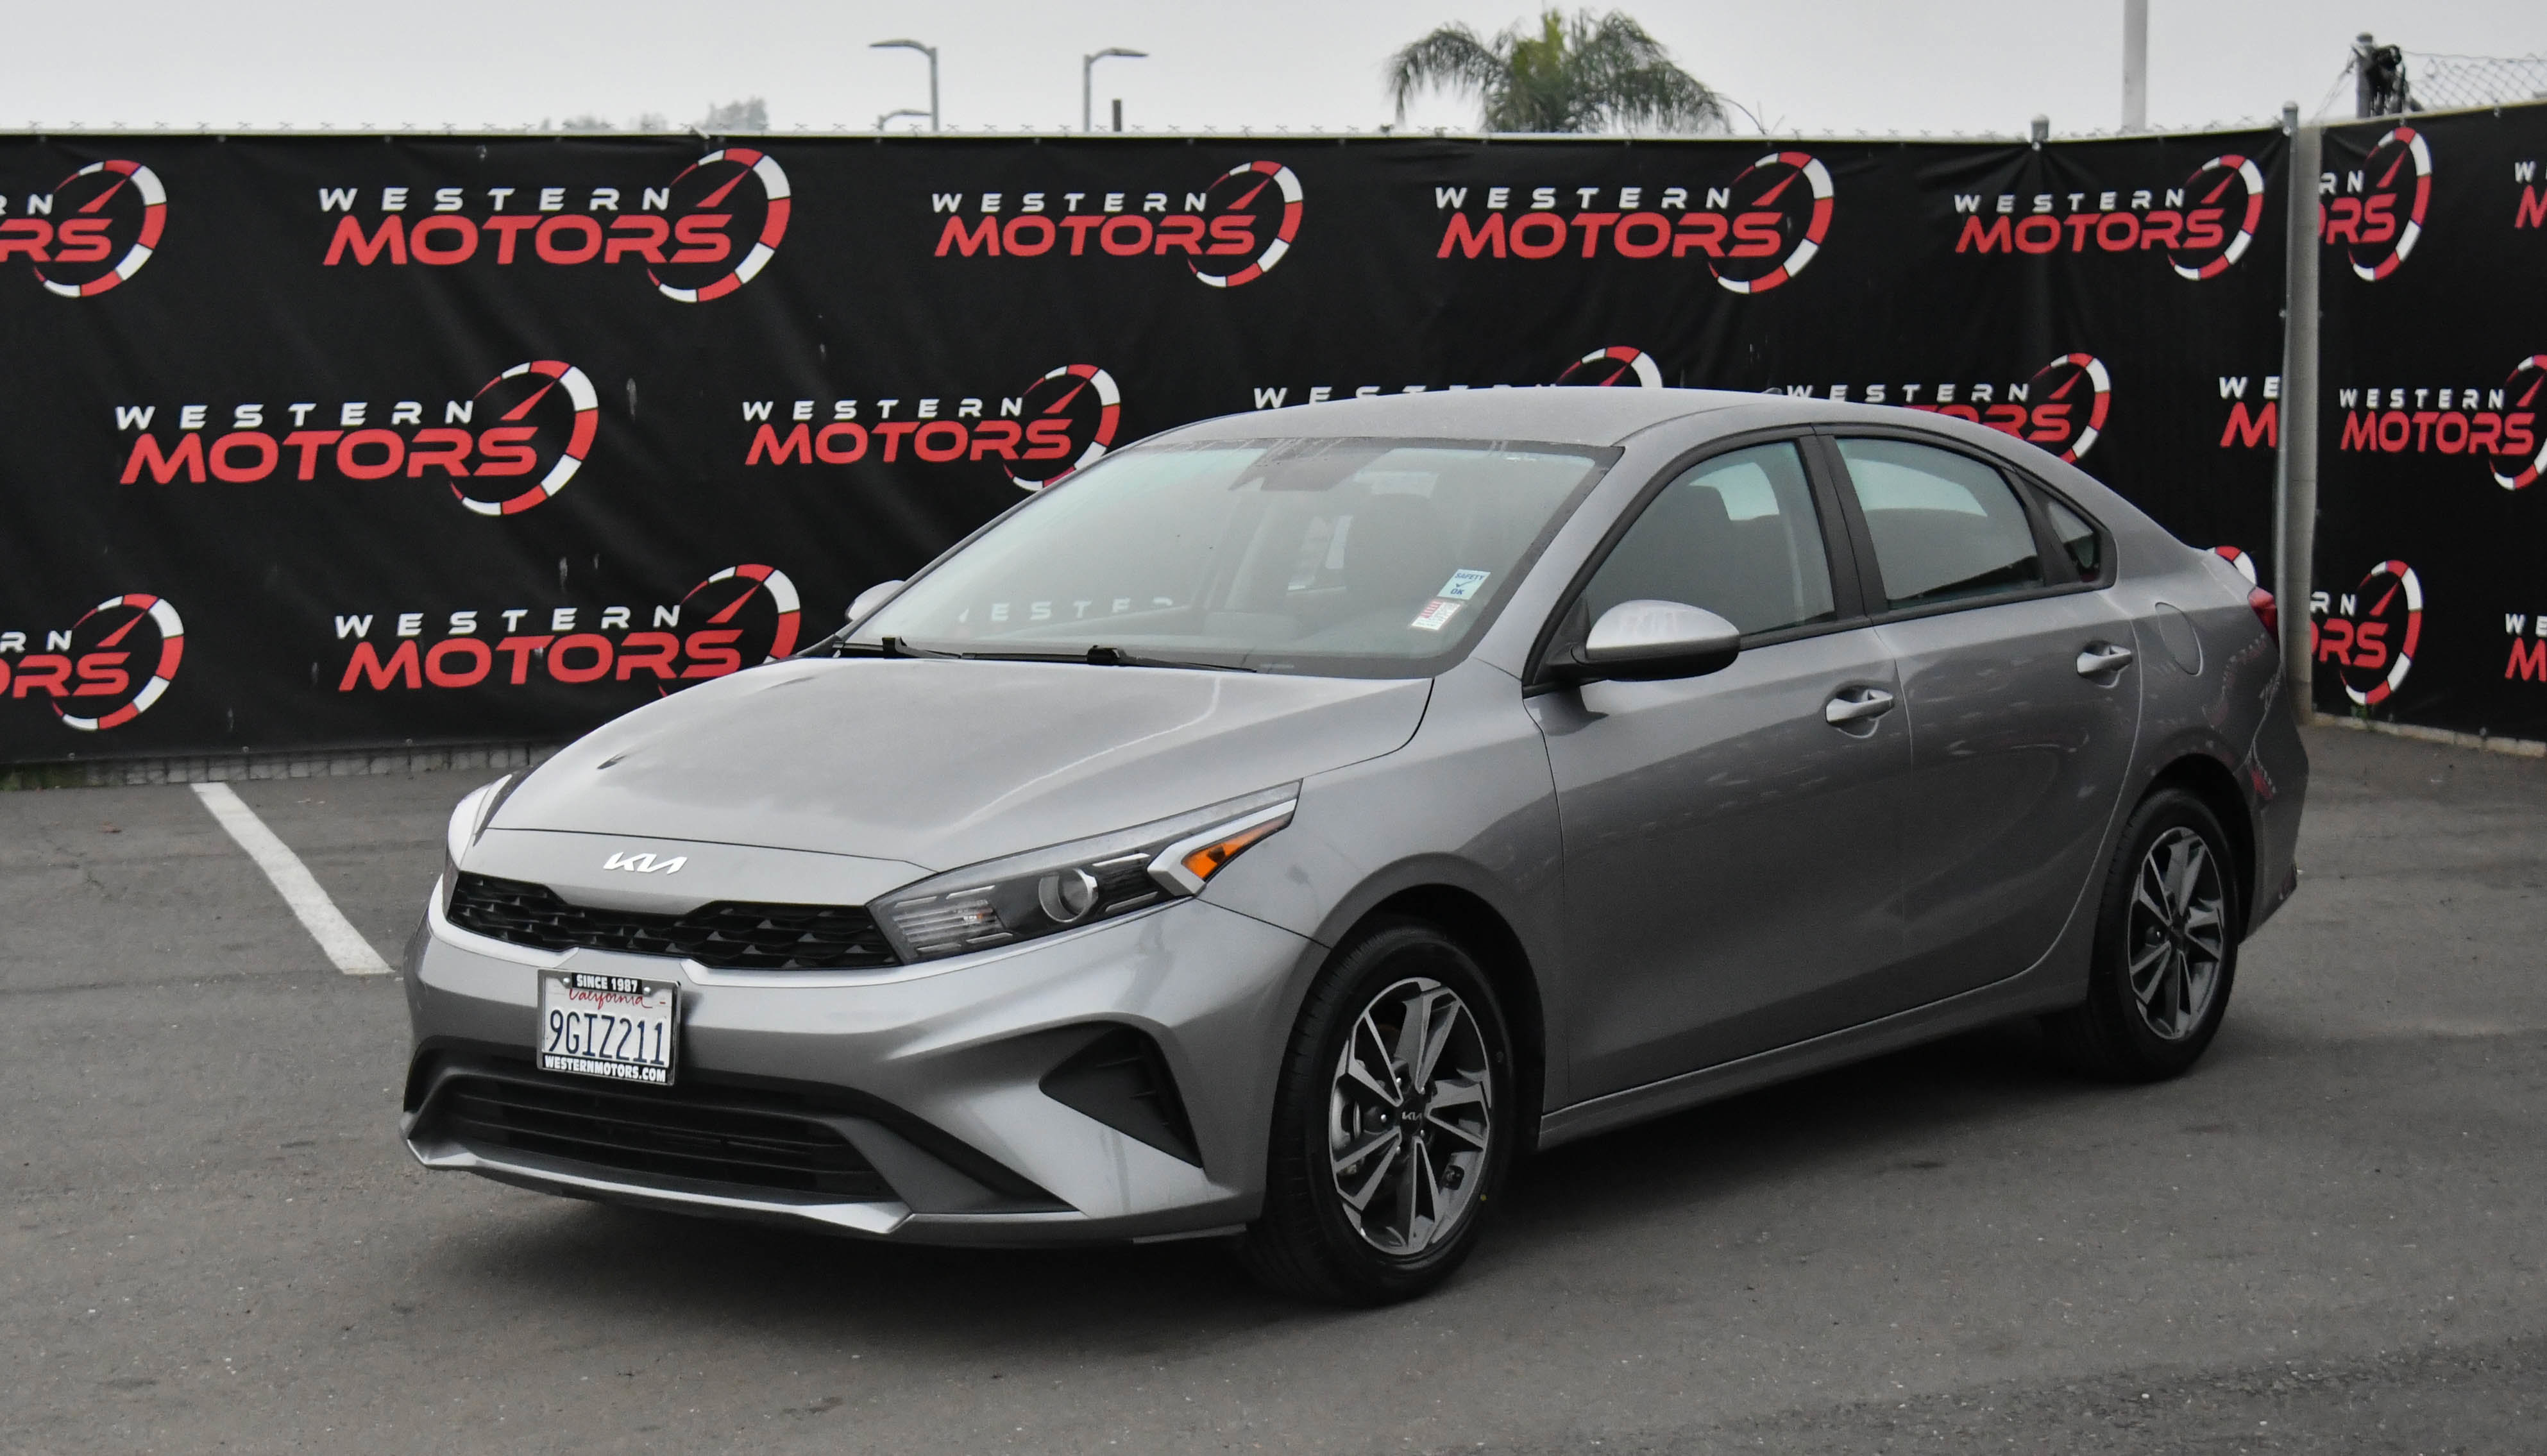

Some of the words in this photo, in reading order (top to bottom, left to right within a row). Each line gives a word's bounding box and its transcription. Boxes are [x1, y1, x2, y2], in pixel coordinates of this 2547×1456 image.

[319, 187, 670, 212] WESTERN
[932, 192, 1206, 213] WESTERN
[1435, 187, 1730, 209] WESTERN
[1954, 189, 2184, 212] WESTERN
[323, 214, 732, 266] MOTORS
[935, 214, 1257, 257] MOTORS
[1437, 212, 1782, 259] MOTORS
[1956, 208, 2224, 254] MOTORS
[1787, 384, 2028, 403] WESTERN
[2339, 388, 2504, 409] WESTERN
[115, 400, 473, 430] WESTERN
[742, 397, 1022, 421] WESTERN
[745, 419, 1073, 466] MOTORS
[2340, 411, 2535, 455] MOTORS
[119, 426, 539, 485] MOTORS
[335, 605, 681, 639] WESTERN
[339, 629, 743, 691] MOTORS
[603, 851, 688, 875] KIA
[577, 974, 608, 990] SINCE
[611, 977, 638, 993] 1987
[548, 1009, 664, 1065] 9GIZ211
[544, 1054, 666, 1083] WESTERNMOTORS.COM
[1402, 1111, 1422, 1121] KIA
